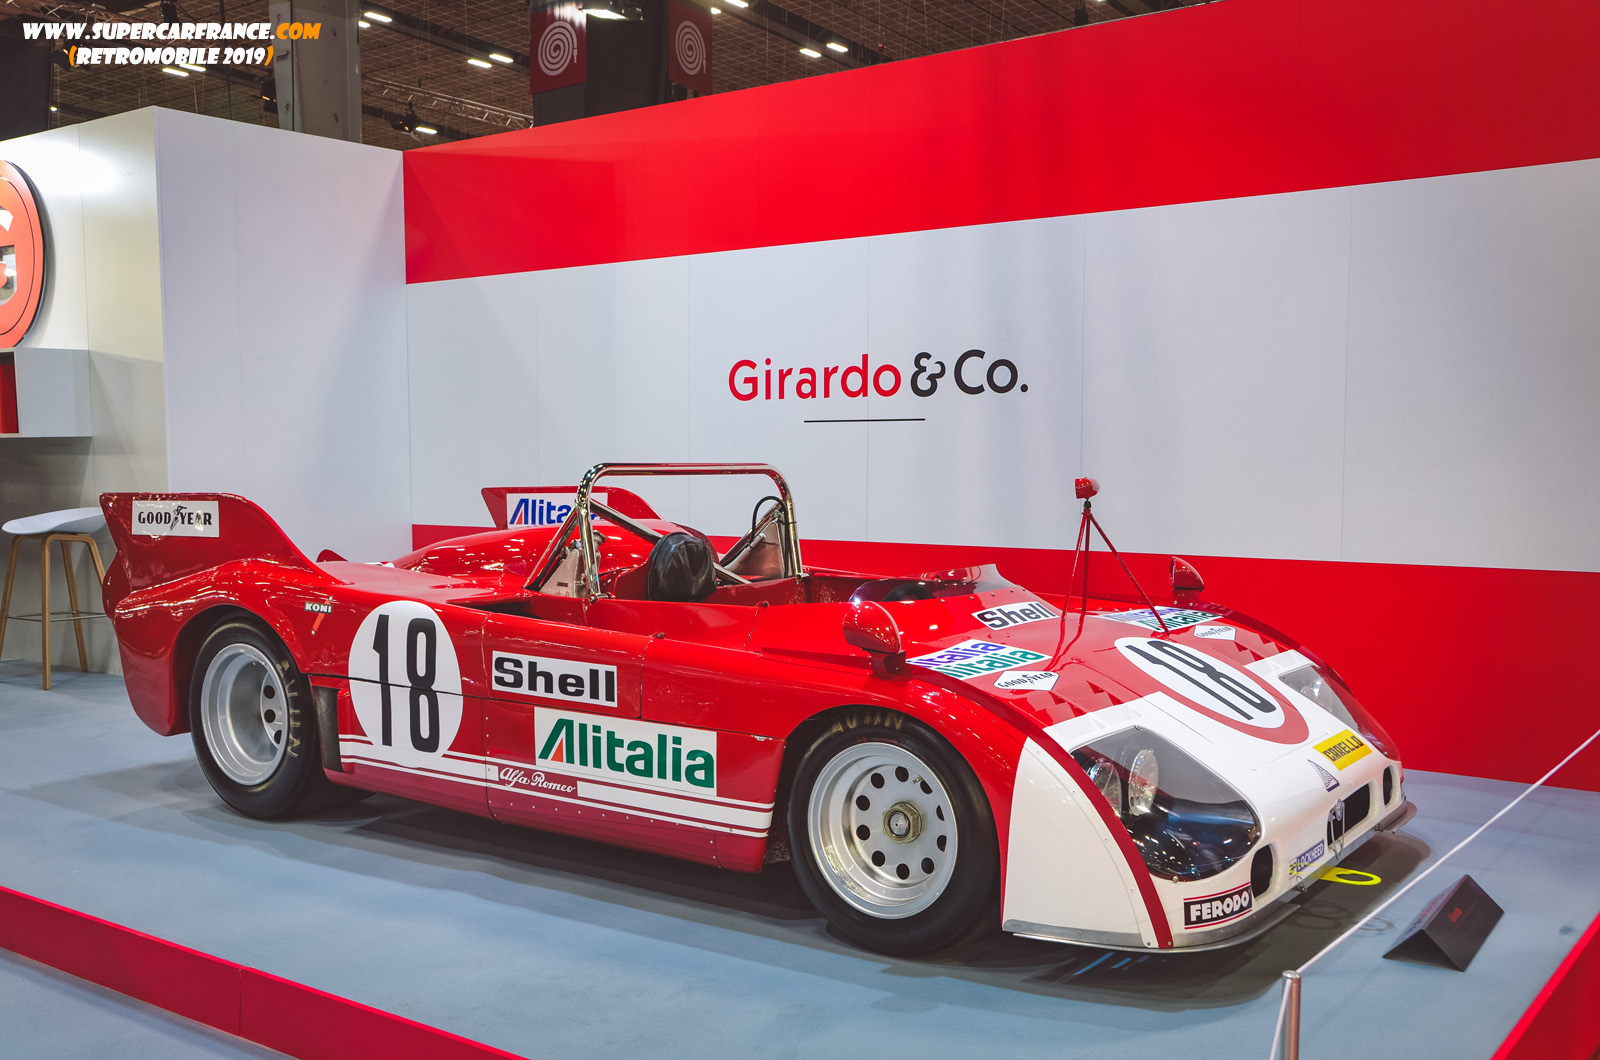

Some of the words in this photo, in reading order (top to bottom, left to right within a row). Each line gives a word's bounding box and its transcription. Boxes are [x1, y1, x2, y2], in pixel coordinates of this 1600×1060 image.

[728, 353, 902, 402] Girardo
[910, 351, 946, 398] &
[953, 348, 1029, 395] Co.
[305, 602, 332, 613] KONI
[976, 602, 1057, 629] Shell
[372, 613, 441, 754] 18
[493, 655, 616, 703] Shell
[1124, 640, 1277, 721] 18
[538, 717, 715, 789] Alitalia
[1322, 735, 1365, 763] CARELLO
[499, 767, 530, 787] Alfa
[530, 771, 577, 793] Romeo
[1190, 890, 1249, 922] FERODO
